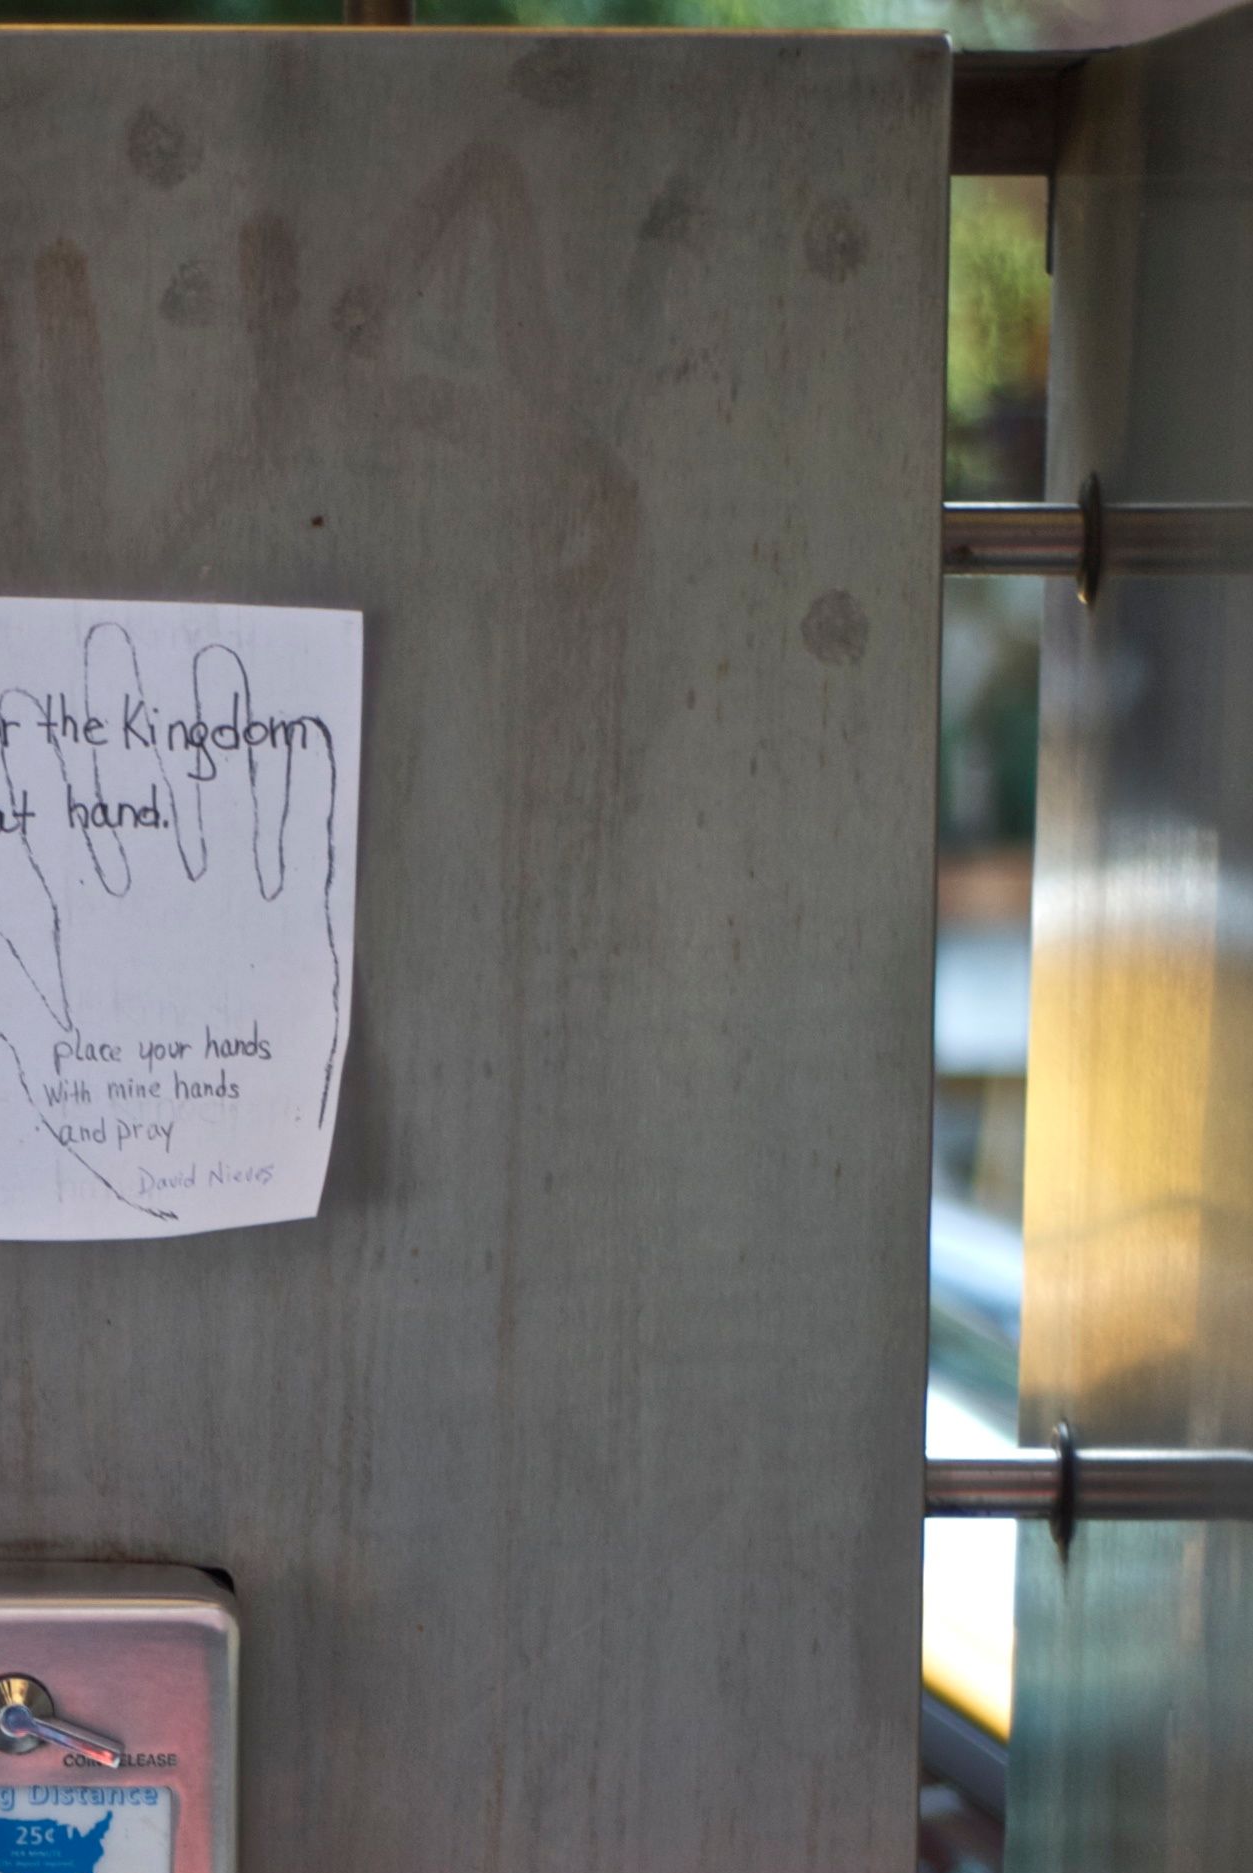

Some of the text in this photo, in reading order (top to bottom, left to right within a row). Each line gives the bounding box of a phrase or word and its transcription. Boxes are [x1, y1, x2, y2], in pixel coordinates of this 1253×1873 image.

[36, 692, 108, 745] the
[66, 783, 170, 829] hand.
[138, 1040, 193, 1074] your
[204, 1018, 273, 1060] hands
[107, 1077, 162, 1100] mine
[173, 1068, 241, 1100] hands
[58, 1116, 175, 1154] and pray
[137, 1162, 196, 1196] David
[116, 1753, 178, 1767] ELEASE
[29, 1785, 159, 1806] Distance
